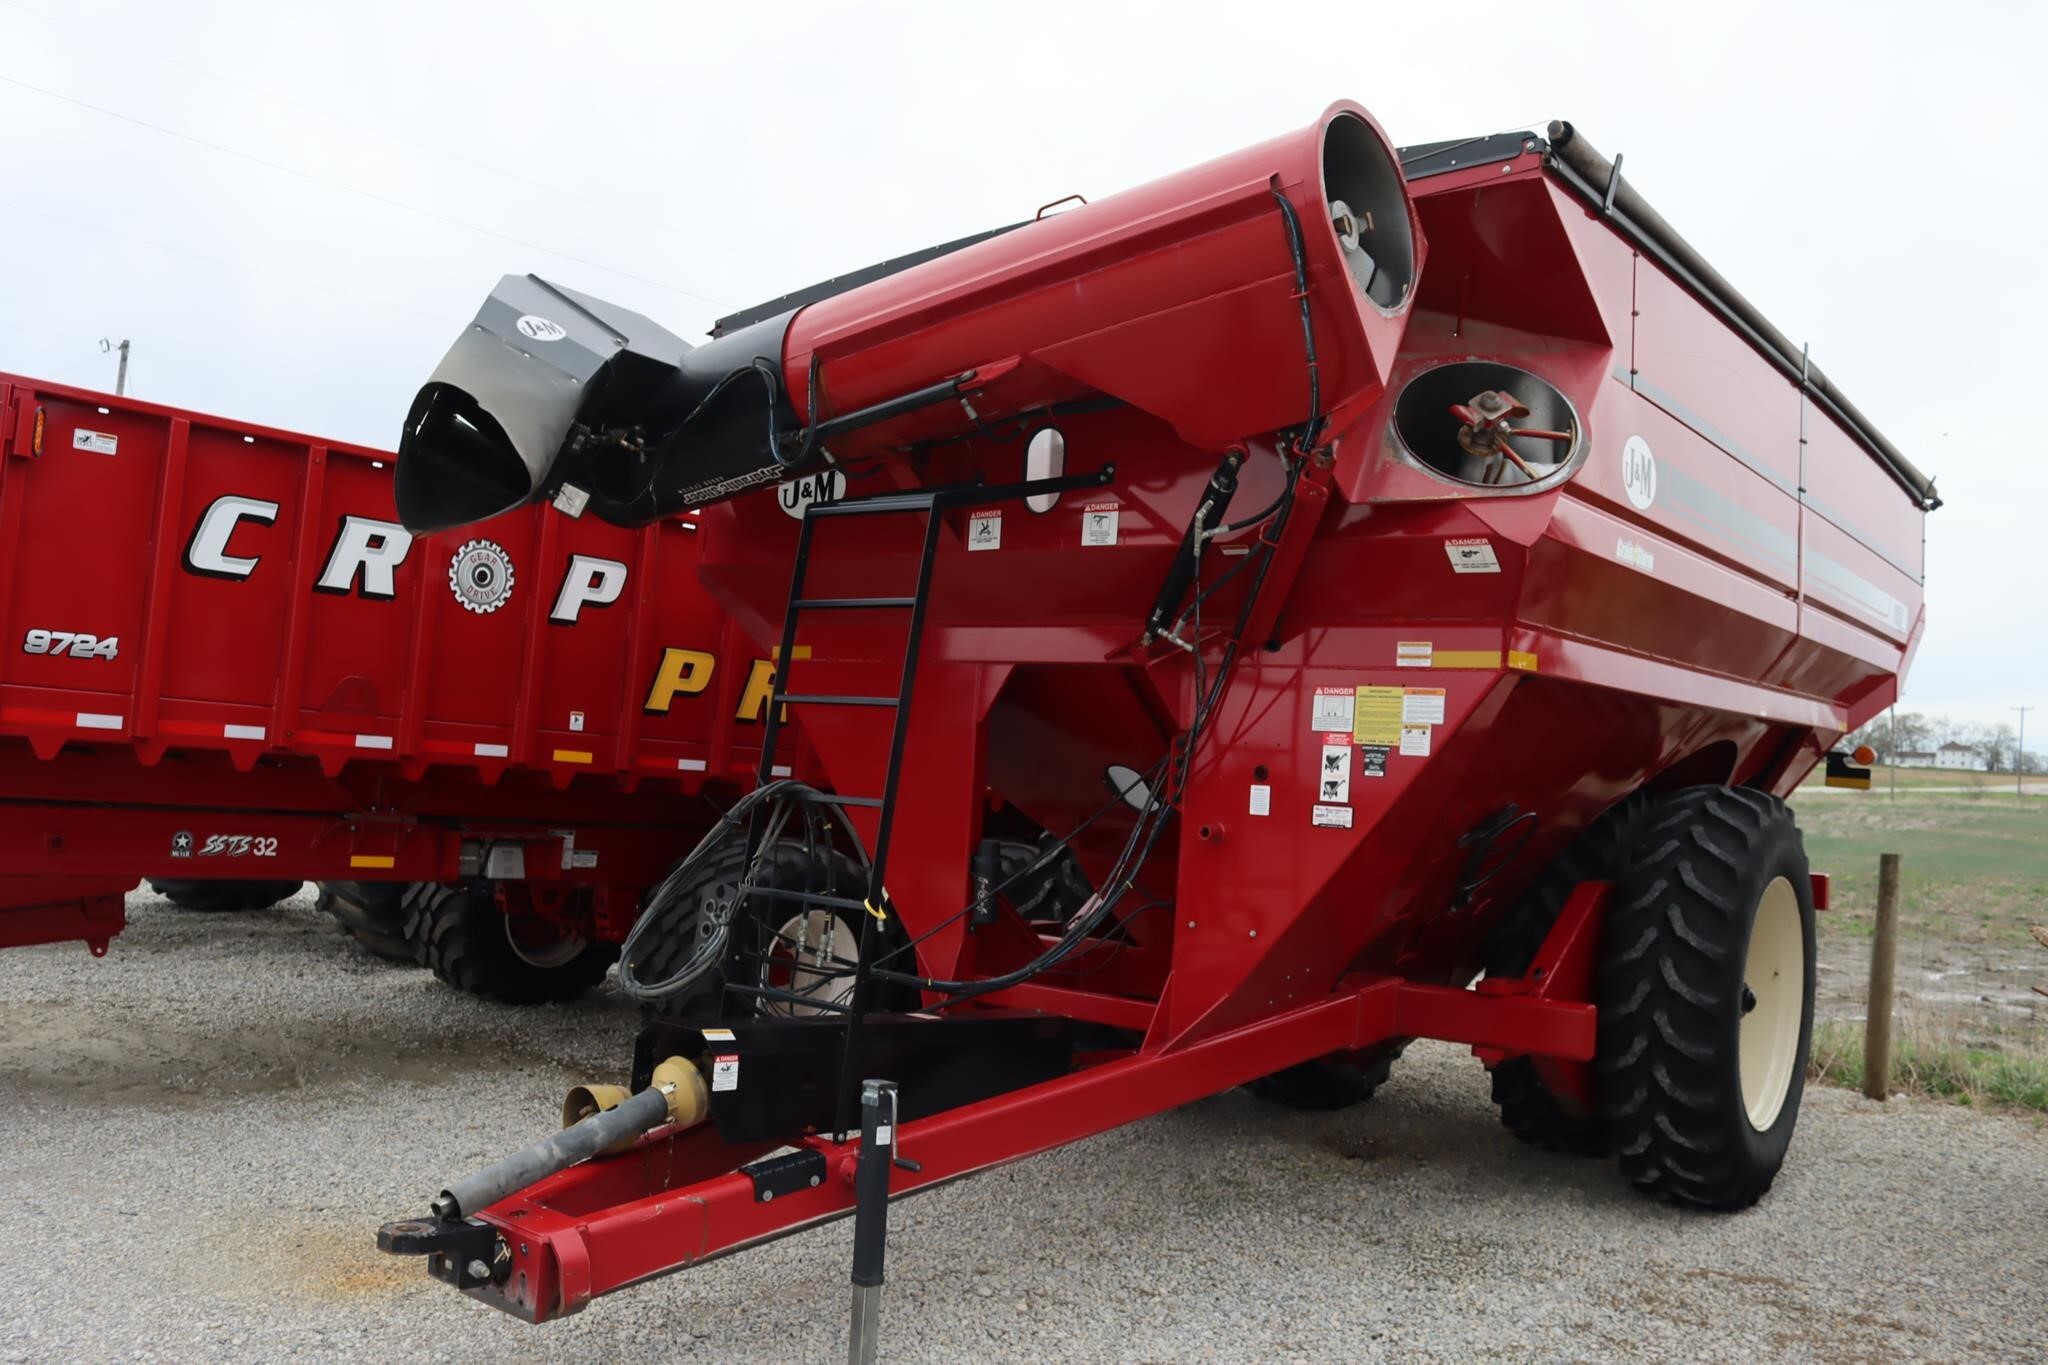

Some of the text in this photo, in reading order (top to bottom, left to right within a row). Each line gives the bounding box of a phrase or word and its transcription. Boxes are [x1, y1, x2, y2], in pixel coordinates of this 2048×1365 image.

[521, 319, 563, 337] J&M
[1624, 446, 1652, 499] J&M
[782, 469, 836, 509] J&M
[1090, 502, 1119, 511] DANGER
[470, 552, 498, 566] GEAR
[466, 585, 497, 600] DRIVE
[24, 629, 119, 660] 9724
[1323, 687, 1354, 695] DANGER
[253, 837, 277, 856] 32
